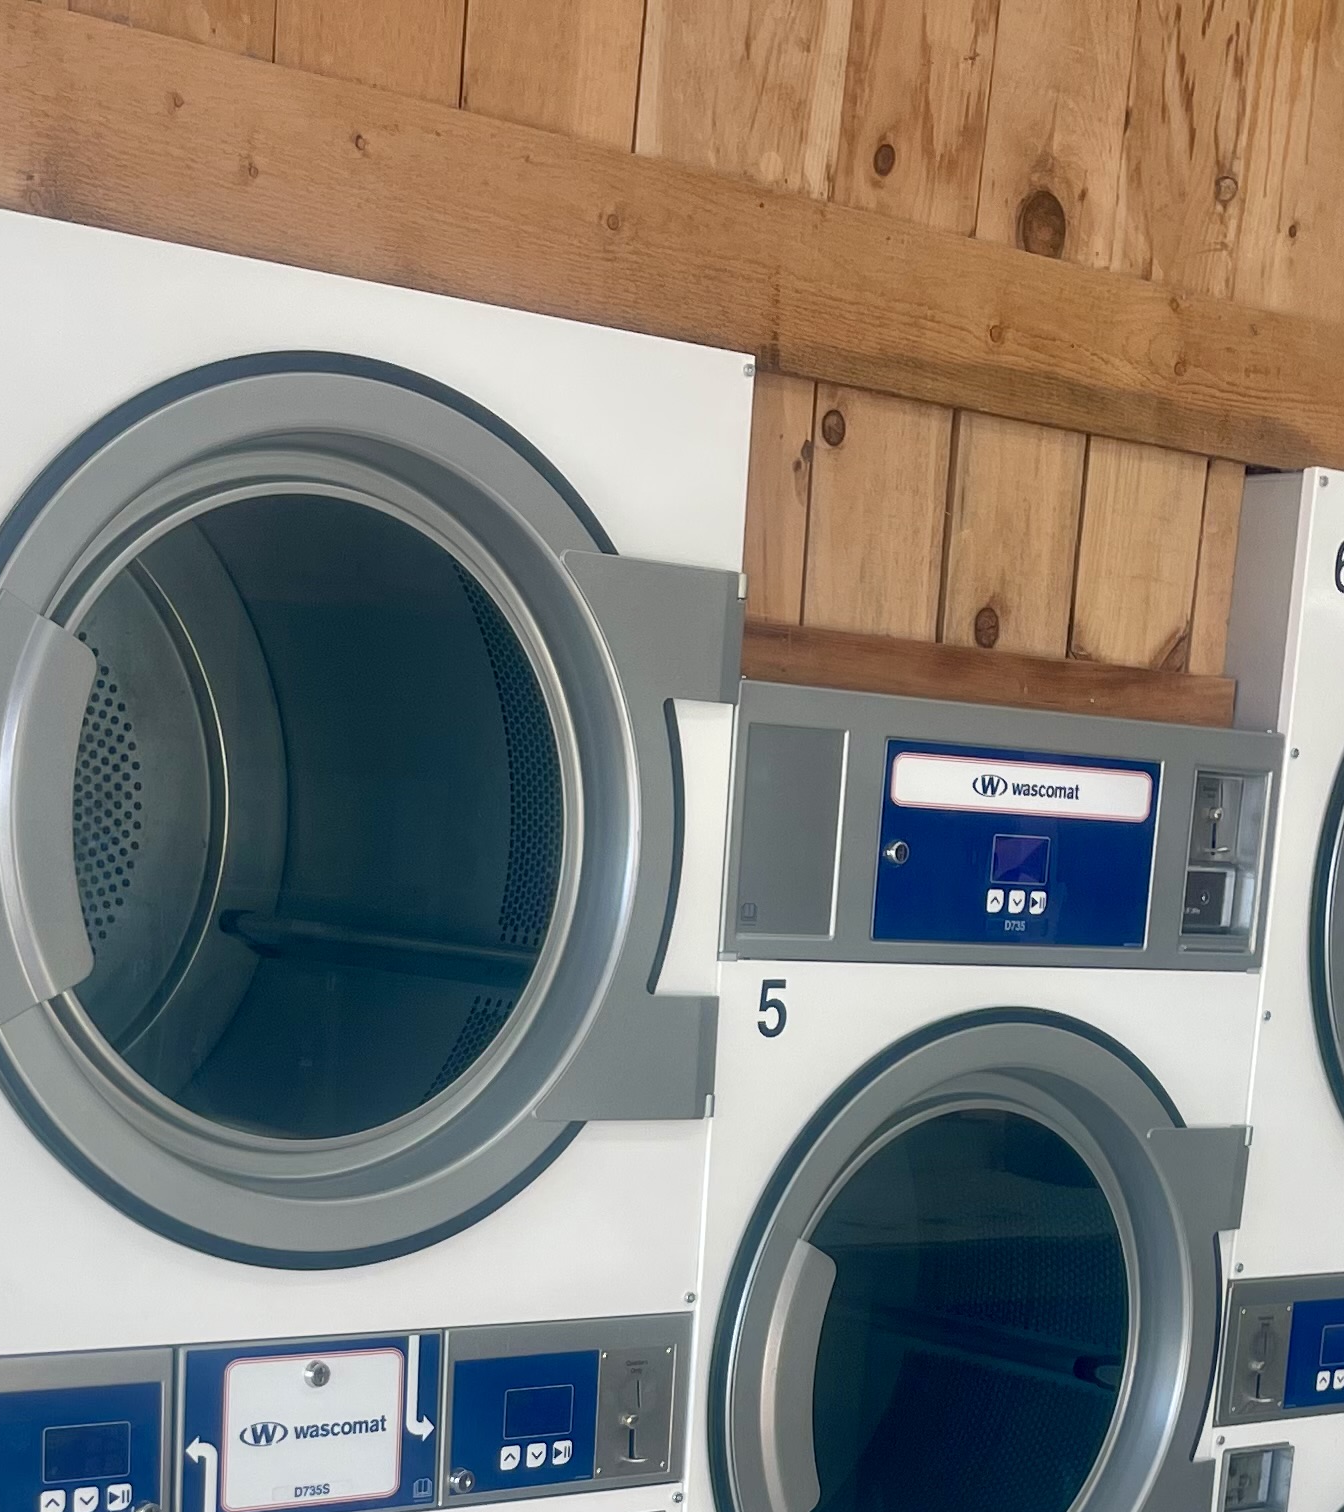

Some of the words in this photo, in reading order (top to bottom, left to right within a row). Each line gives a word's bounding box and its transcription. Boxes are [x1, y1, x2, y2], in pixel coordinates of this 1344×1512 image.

[1011, 782, 1081, 801] wascomat
[1004, 919, 1026, 932] D735
[757, 978, 787, 1038] 5
[293, 1414, 388, 1440] wascomat
[293, 1482, 331, 1499] D735S
